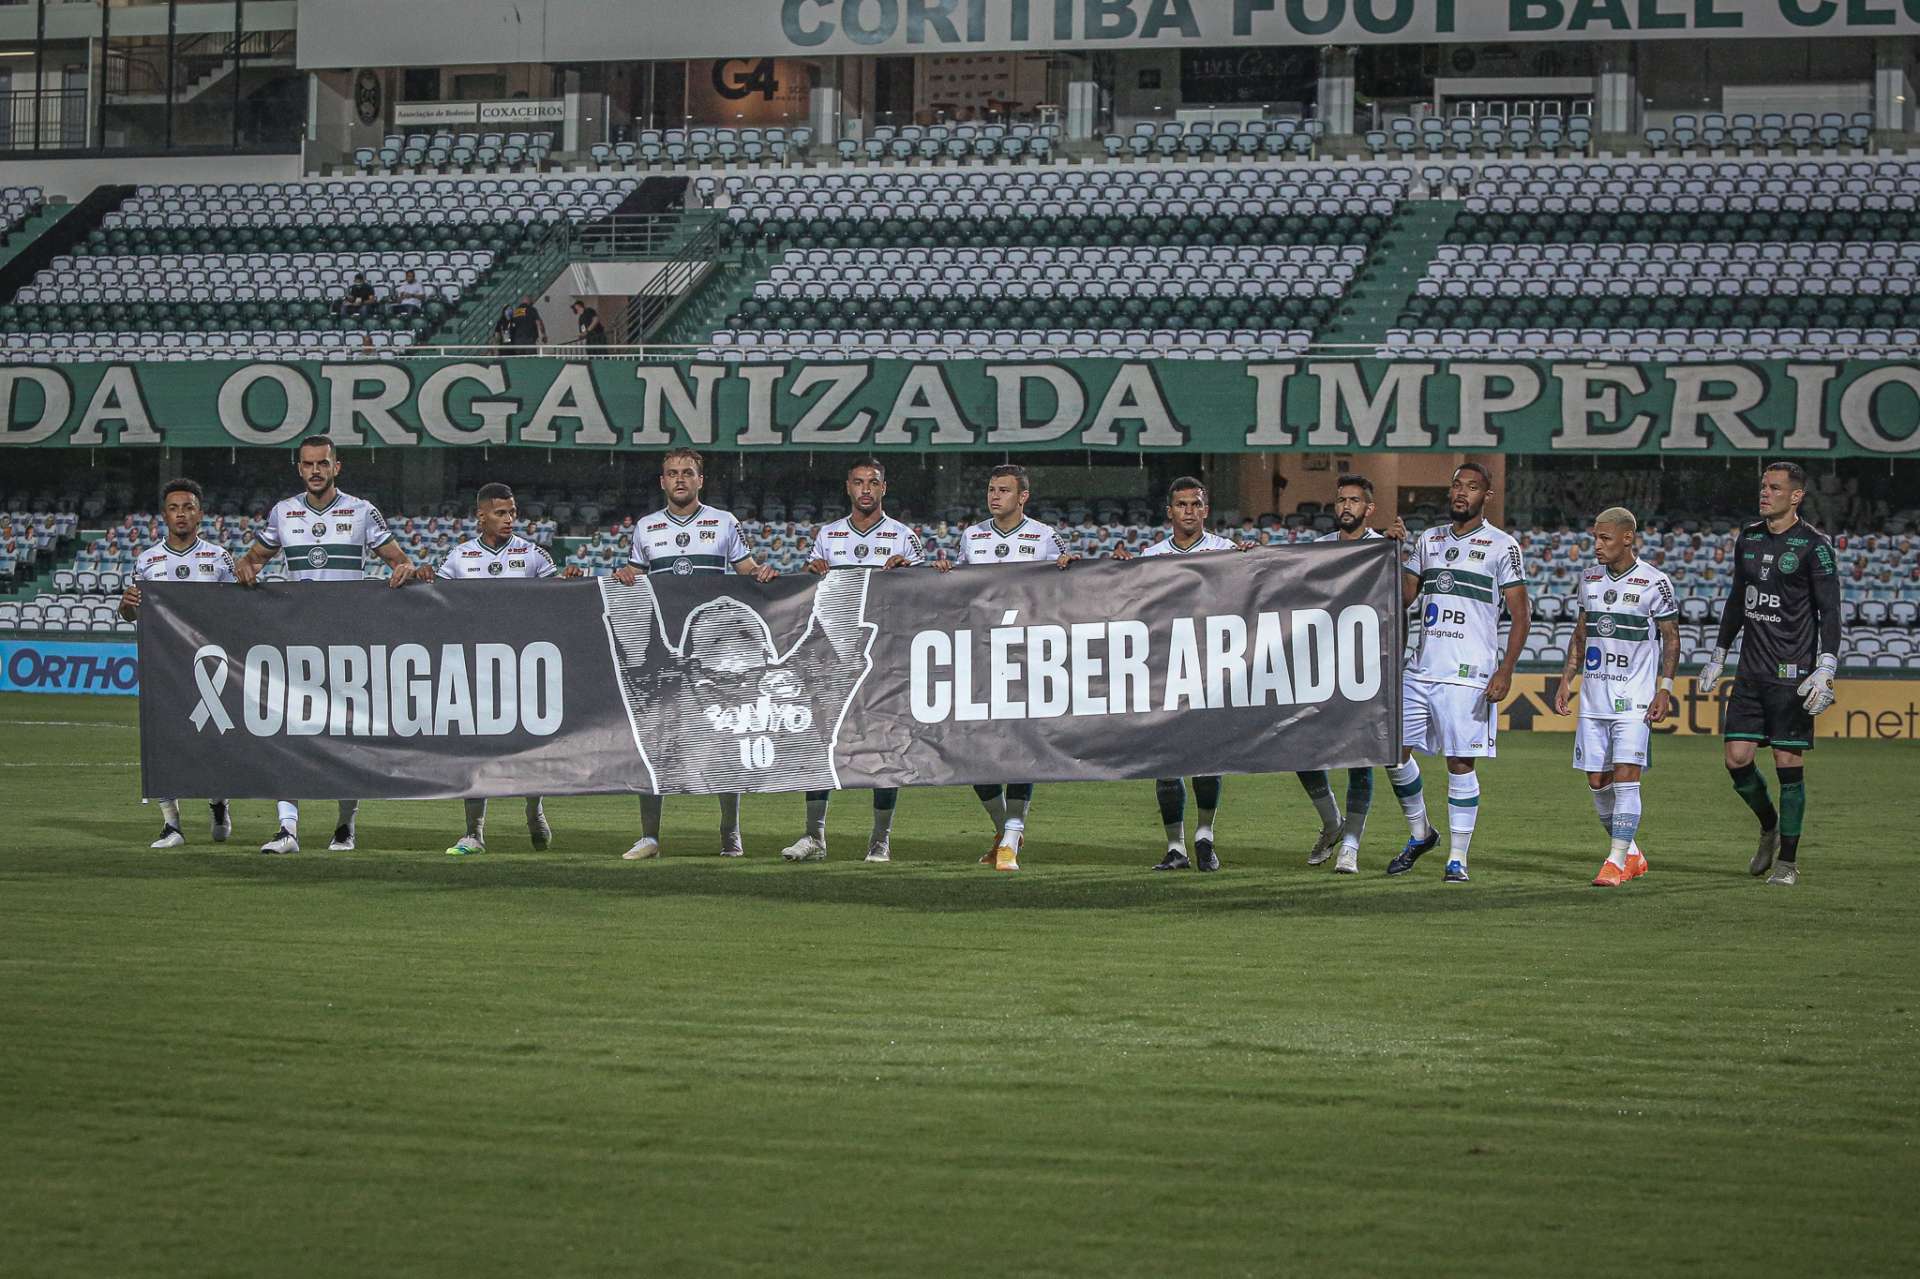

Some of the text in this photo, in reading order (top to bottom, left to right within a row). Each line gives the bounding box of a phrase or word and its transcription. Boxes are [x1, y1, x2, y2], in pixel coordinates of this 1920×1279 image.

[780, 0, 1202, 47] CORITIBA
[711, 57, 779, 101] G4
[482, 106, 563, 118] COXACEIROS
[217, 363, 1188, 448] ORGANIZADA
[1441, 609, 1466, 625] PB
[1758, 592, 1781, 608] PB
[8, 647, 139, 690] ORTHO
[909, 604, 1382, 724] CLÉBER ARADO
[1605, 652, 1629, 668] PB
[243, 641, 563, 737] OBRIGADO
[1834, 702, 1920, 739] .net
